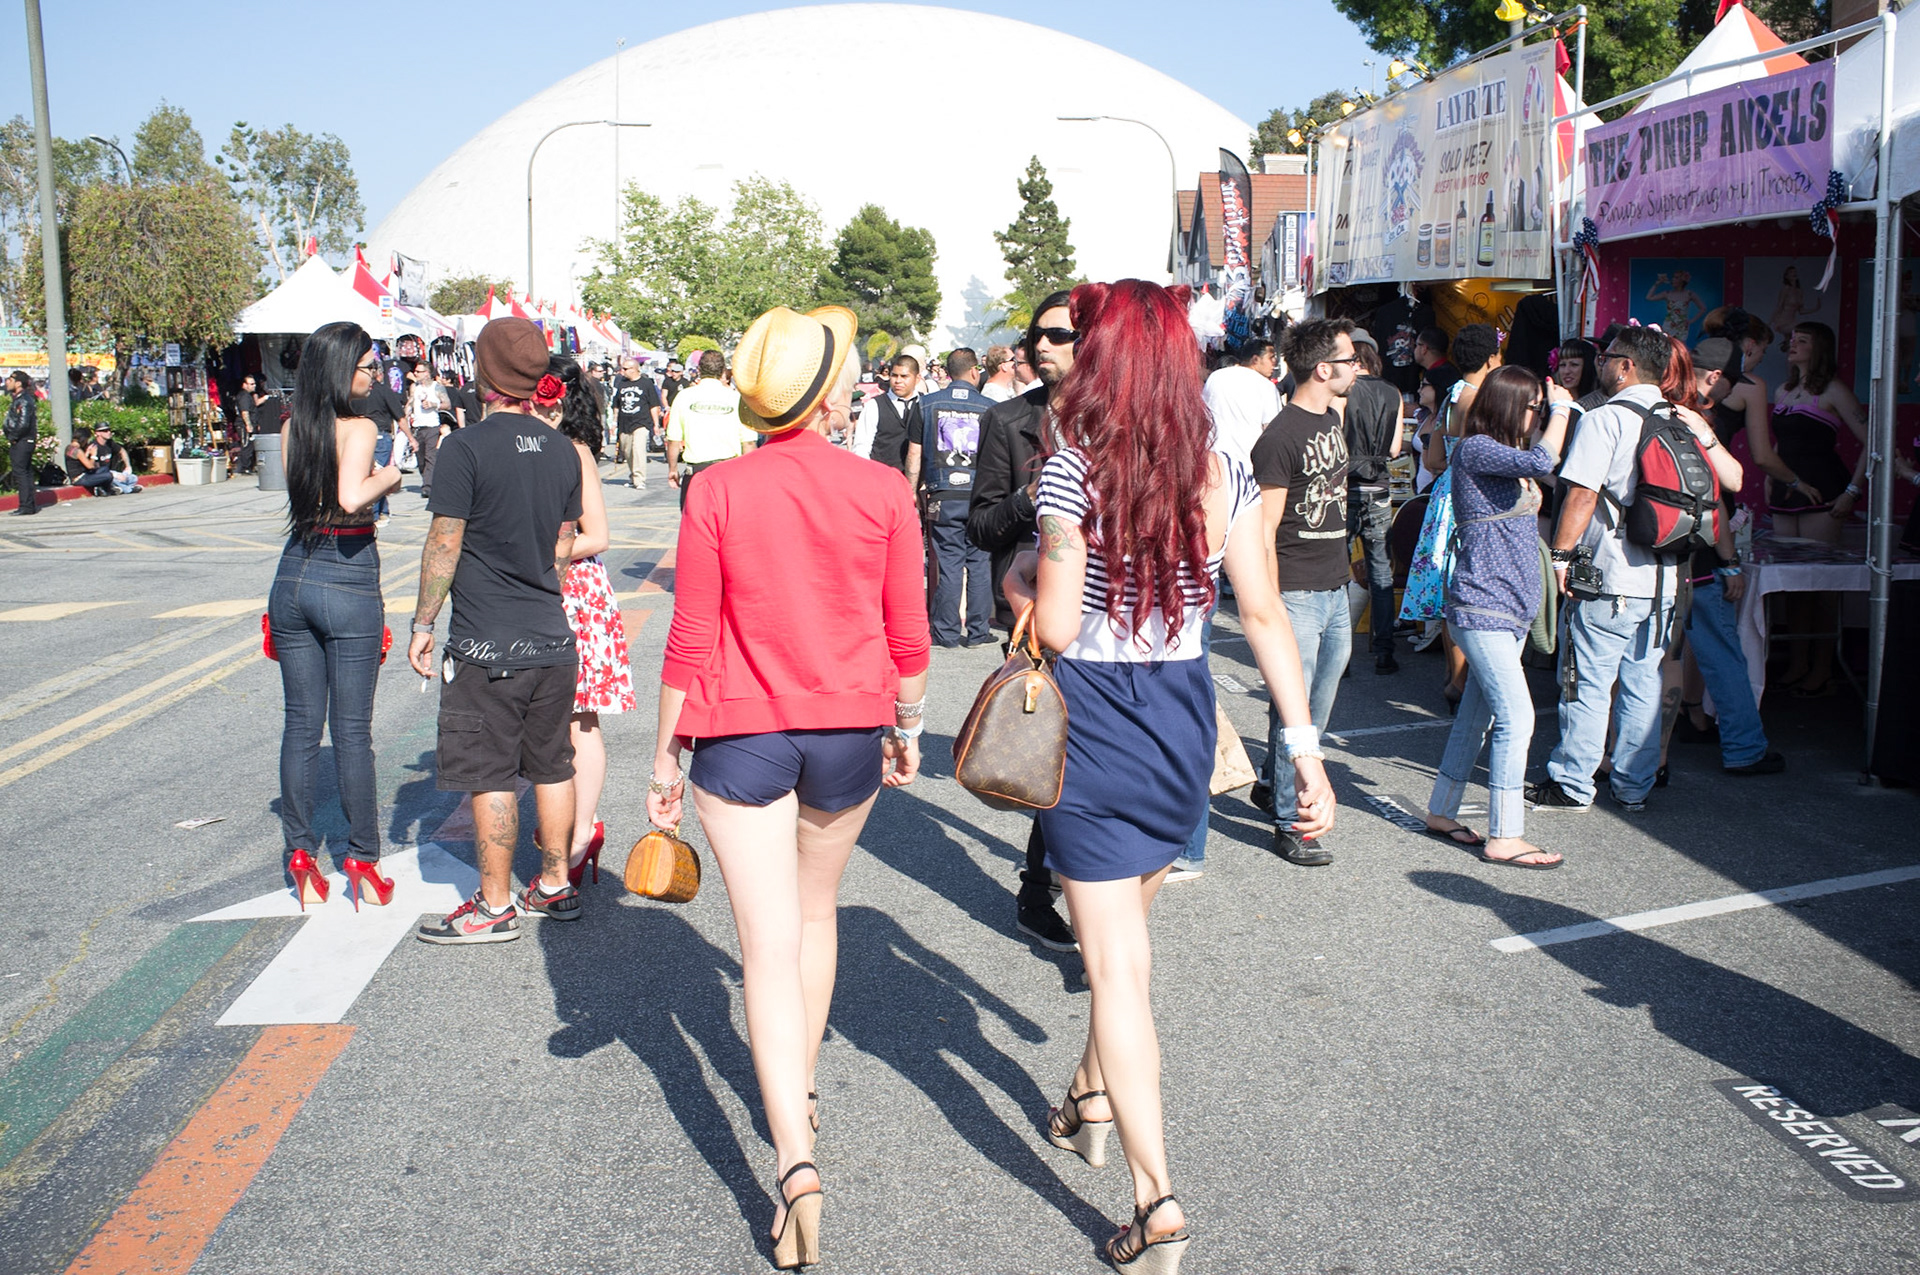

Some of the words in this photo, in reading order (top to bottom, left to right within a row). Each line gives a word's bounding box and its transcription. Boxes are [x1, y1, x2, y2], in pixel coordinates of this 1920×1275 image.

[1589, 133, 1632, 187] THE
[1640, 110, 1708, 175] PINUP
[1720, 80, 1827, 157] ANGELS
[1759, 167, 1813, 201] Troops
[1732, 1085, 1905, 1189] RESERVED
